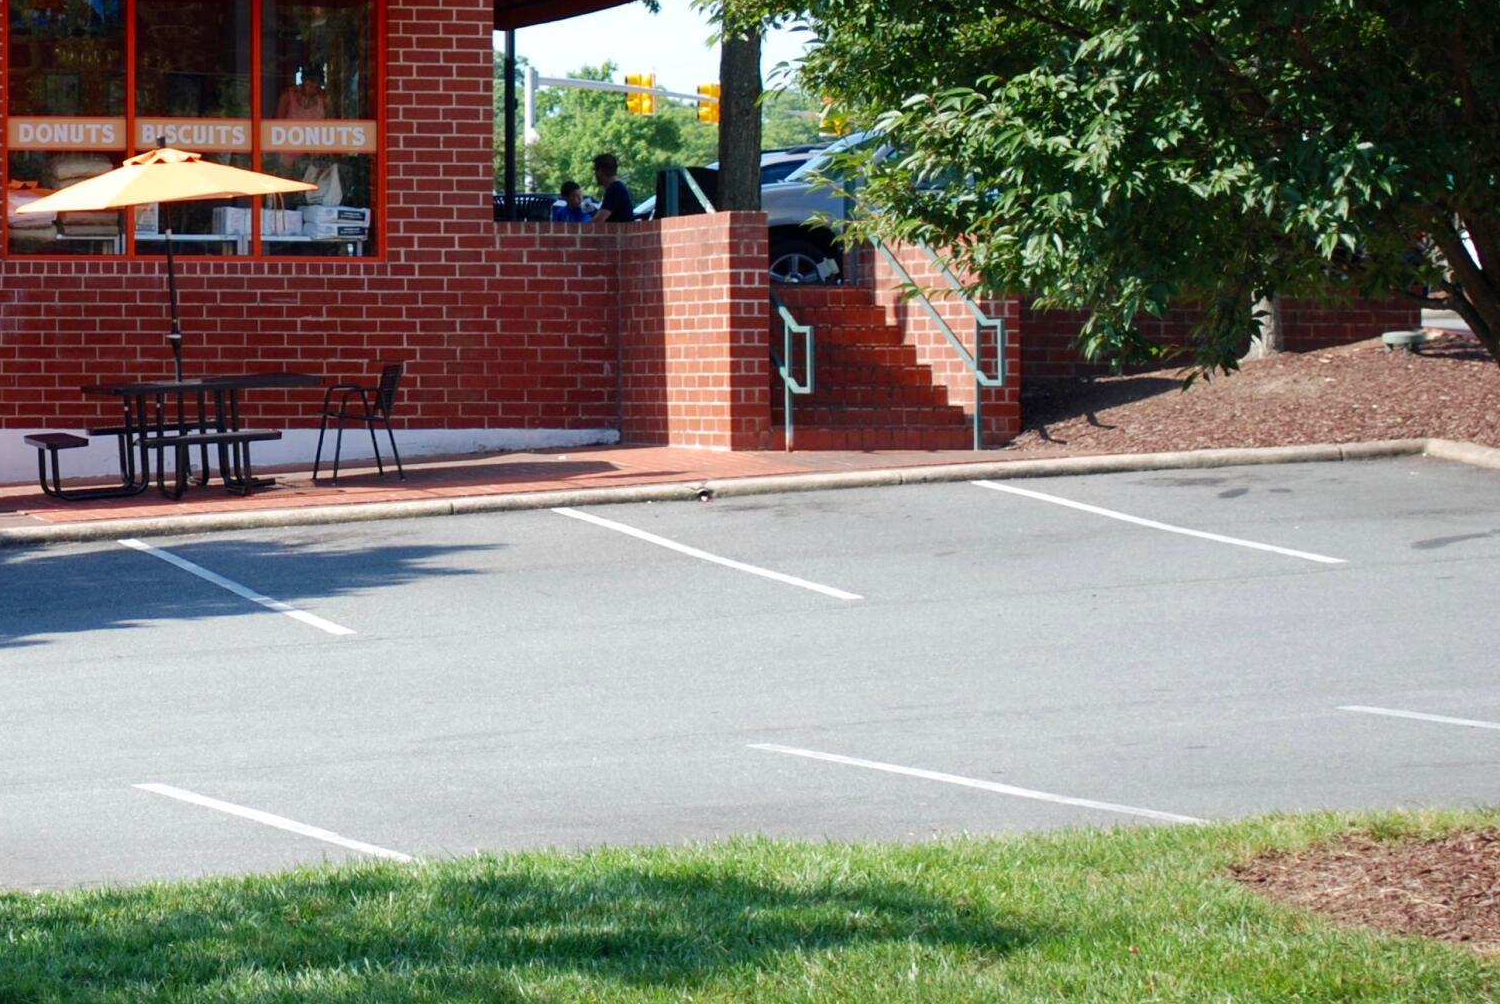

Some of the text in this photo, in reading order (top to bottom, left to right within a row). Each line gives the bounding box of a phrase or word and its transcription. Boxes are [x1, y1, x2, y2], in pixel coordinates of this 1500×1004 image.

[18, 123, 116, 144] DONUTS
[141, 124, 246, 145] BISCUITS
[271, 126, 366, 147] DONUTS
